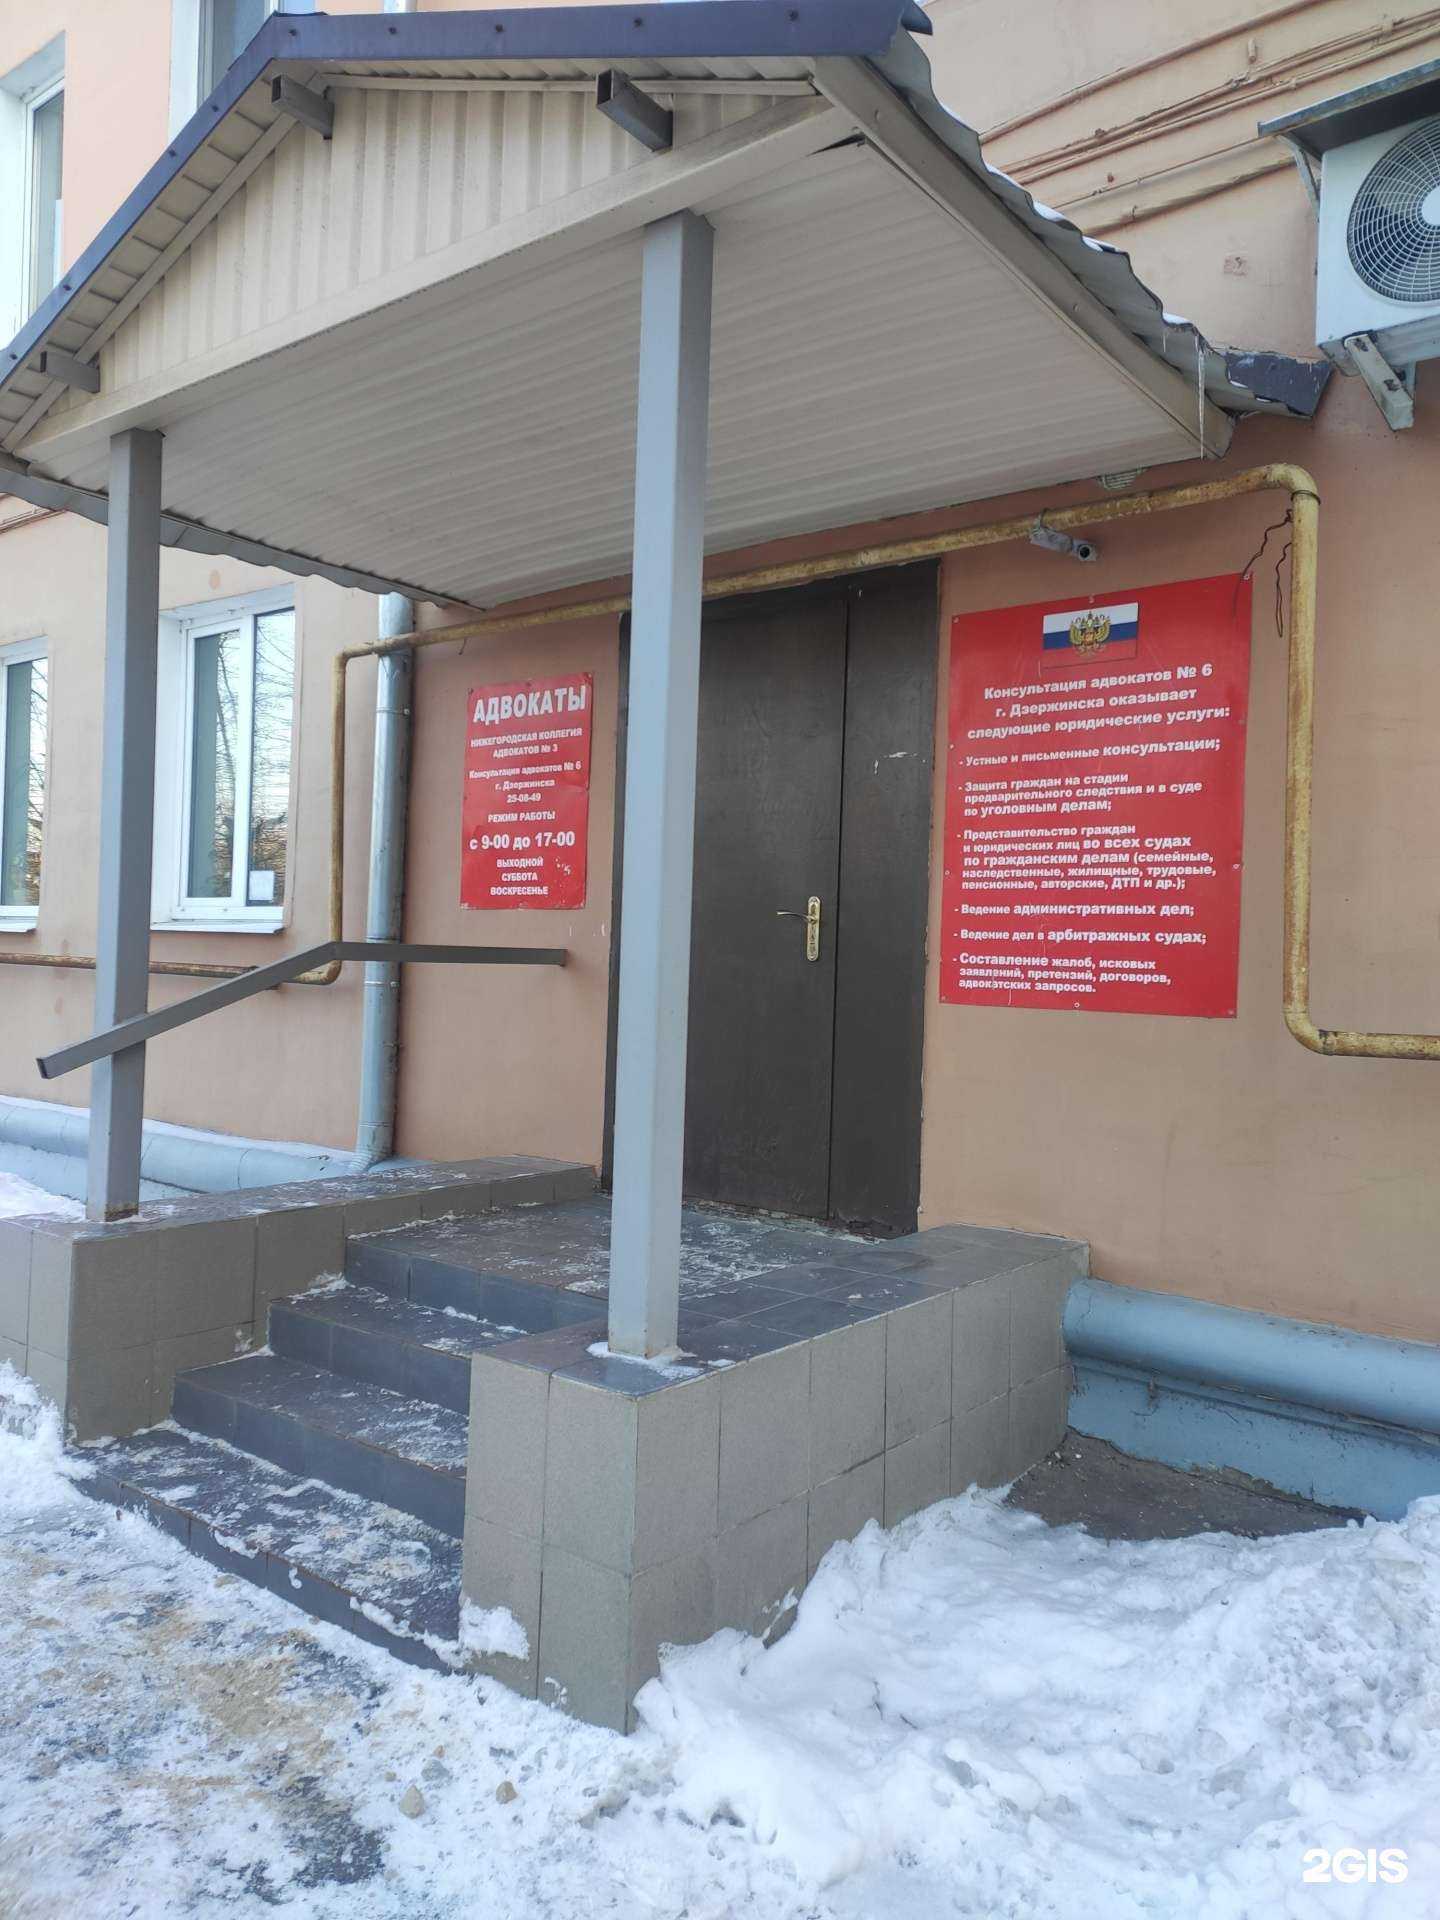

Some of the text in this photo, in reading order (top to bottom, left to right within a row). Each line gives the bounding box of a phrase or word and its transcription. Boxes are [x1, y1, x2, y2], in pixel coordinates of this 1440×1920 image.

[984, 664, 1212, 699] Консультация адвокатов № 6
[473, 685, 586, 725] АДВОКАТЫ
[995, 688, 1196, 717] г. Дзержинска оказывает
[968, 707, 1230, 740] следующие юридические услуги:
[471, 728, 582, 747] НИЖЕГОРОДСКАЯ КОЛЛЕГИЯ
[493, 746, 539, 758] АДВОКАТОВ
[966, 755, 1007, 767] Устные
[1011, 753, 1018, 762] и
[1021, 748, 1099, 763] письменные
[1103, 737, 1220, 756] консультации;
[469, 761, 581, 779] Консультация адвокатов № 6
[503, 779, 554, 791] Дзержинска
[965, 780, 1007, 792] Защита
[1011, 775, 1061, 791] граждан
[1065, 777, 1080, 785] на
[1084, 772, 1128, 785] стадии
[965, 781, 1202, 804] предварительного следствия и в суде
[488, 811, 555, 823] РЕЖИМ РАБОТЫ
[965, 800, 1112, 818] по уголовным делам;
[964, 826, 1077, 840] Представительство
[1081, 824, 1136, 838] граждан
[481, 834, 509, 849] 9-00
[513, 837, 530, 850] до
[535, 831, 575, 847] 17-00
[974, 840, 1053, 852] юридических
[1056, 840, 1080, 851] лиц
[1084, 839, 1099, 849] во
[1104, 838, 1140, 848] всех
[1145, 836, 1191, 849] судах
[497, 857, 543, 867] ВЫХОДНОЙ
[964, 851, 1213, 866] по гражданским делам (семейные,
[502, 873, 537, 881] СУББОТА
[962, 865, 1216, 878] наследственные, жилищные, трудовые,
[490, 886, 548, 895] ВОСКРЕСЕНЬЕ
[962, 877, 1185, 890] пенсионные, авторские, ДТП и др.);
[961, 904, 1010, 915] Ведение
[1014, 903, 1155, 916] административных
[1160, 904, 1194, 917] дел;
[960, 930, 1009, 941] Ведение
[1012, 931, 1034, 941] дел
[1048, 929, 1150, 942] арбитражных
[1155, 931, 1207, 944] судах;
[960, 953, 1048, 966] Составление
[1052, 956, 1095, 968] жалоб,
[1099, 959, 1156, 969] исковых
[959, 968, 1171, 984] заявлений, претензий, договоров,
[959, 979, 1096, 993] адвокатских запросов.
